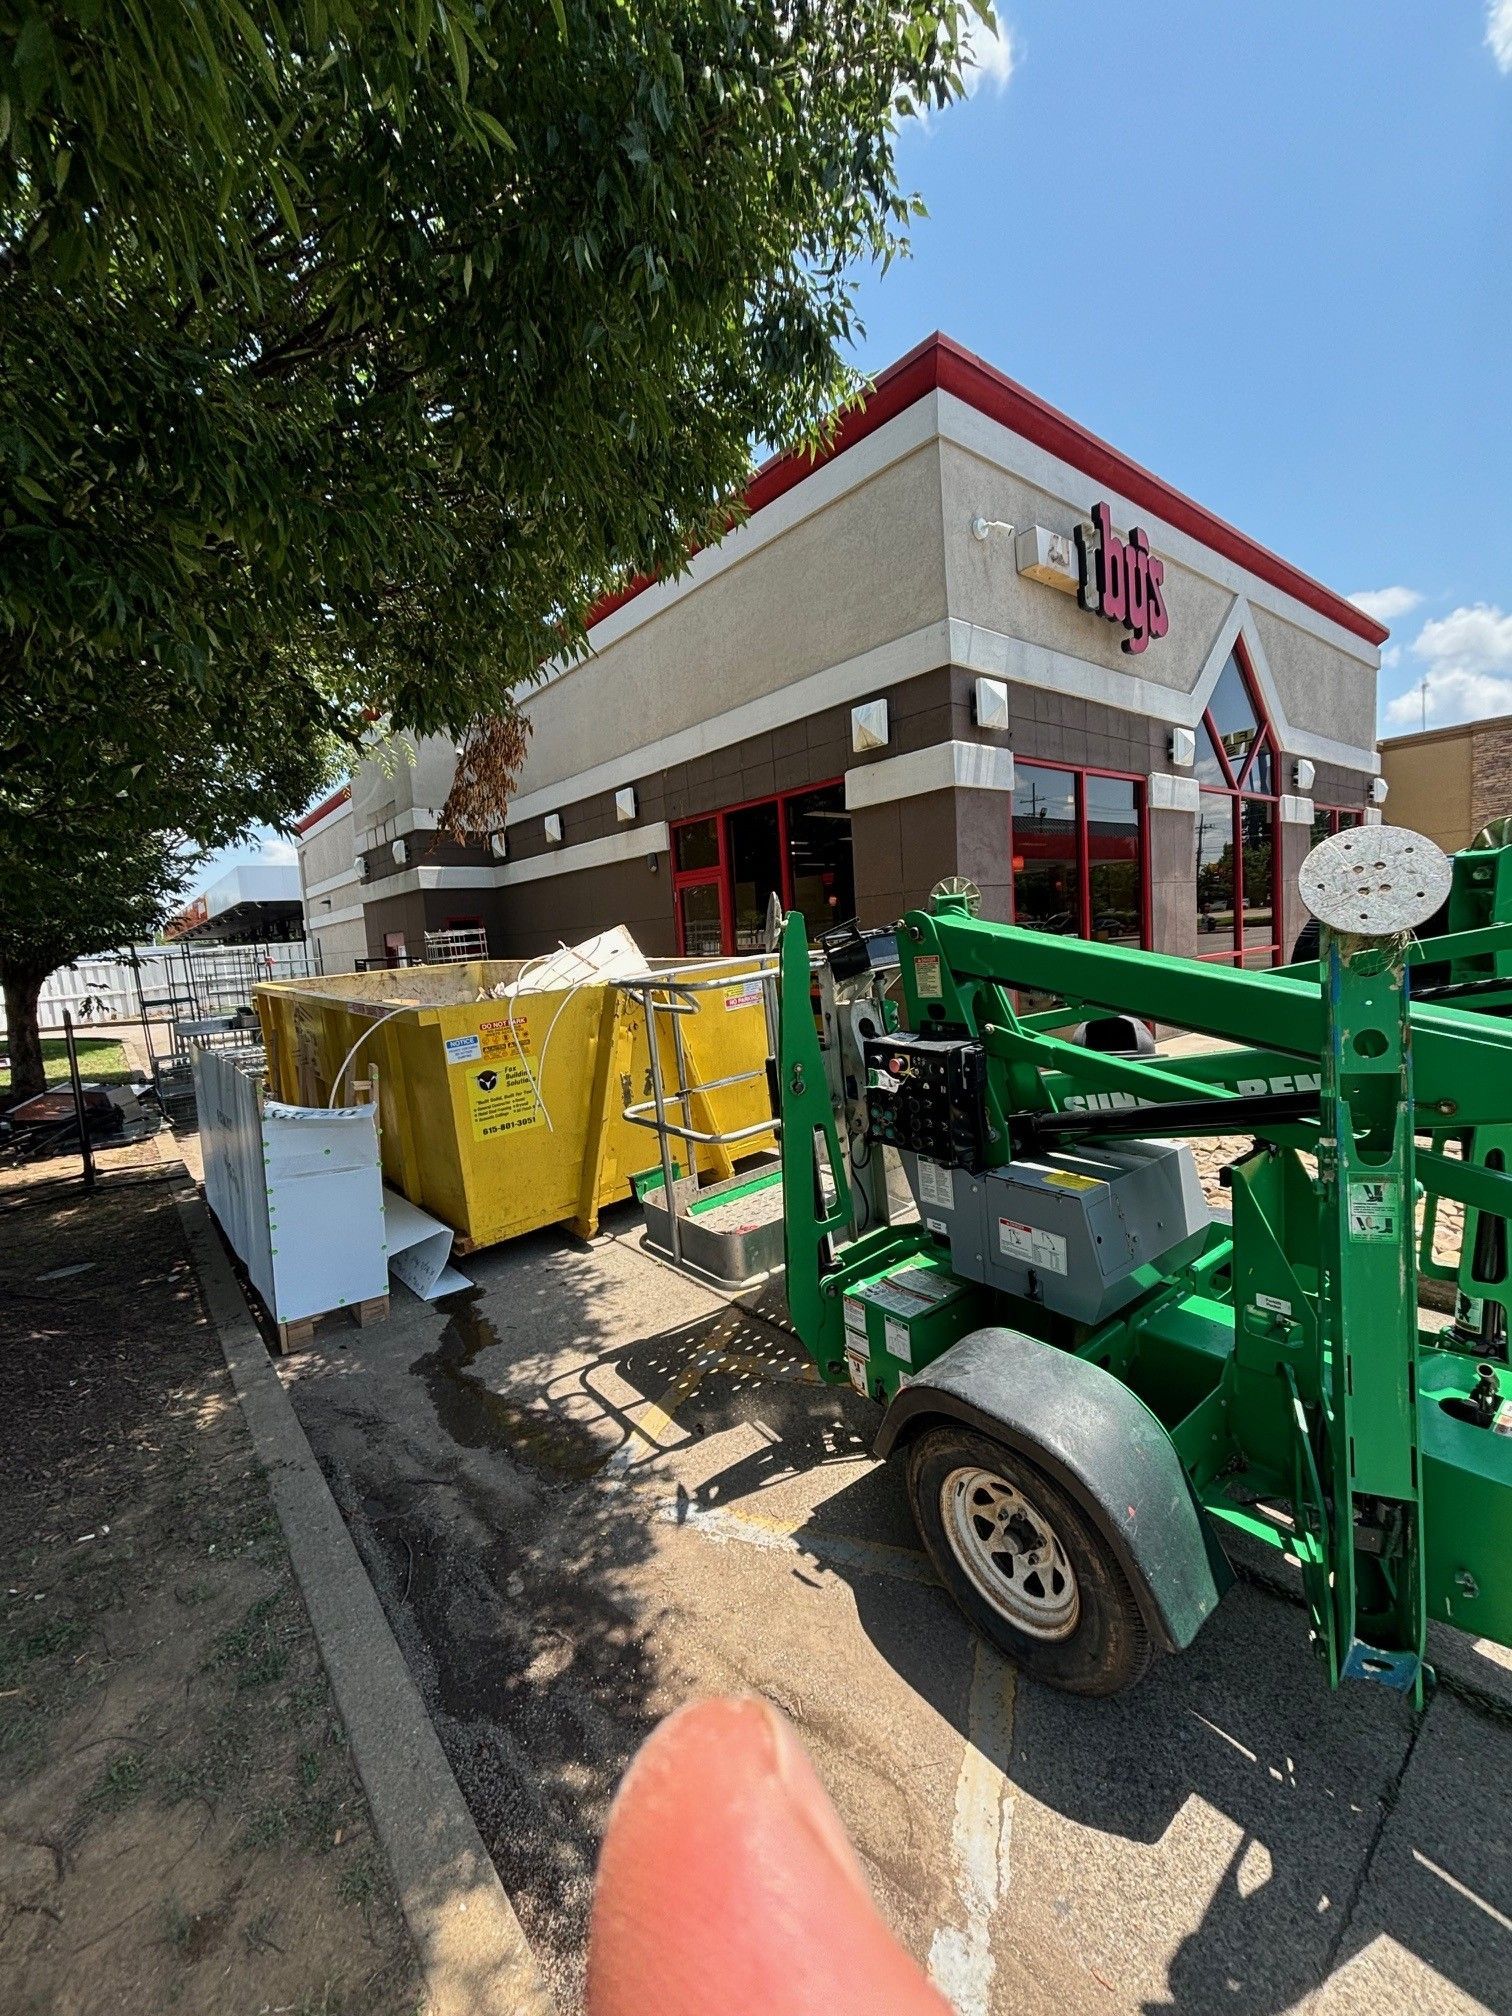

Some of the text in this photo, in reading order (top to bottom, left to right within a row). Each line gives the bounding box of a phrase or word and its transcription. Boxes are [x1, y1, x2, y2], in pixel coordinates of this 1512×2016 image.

[493, 1021, 507, 1029] NOT
[450, 1037, 475, 1048] NOTICE
[506, 1076, 536, 1087] Solutios
